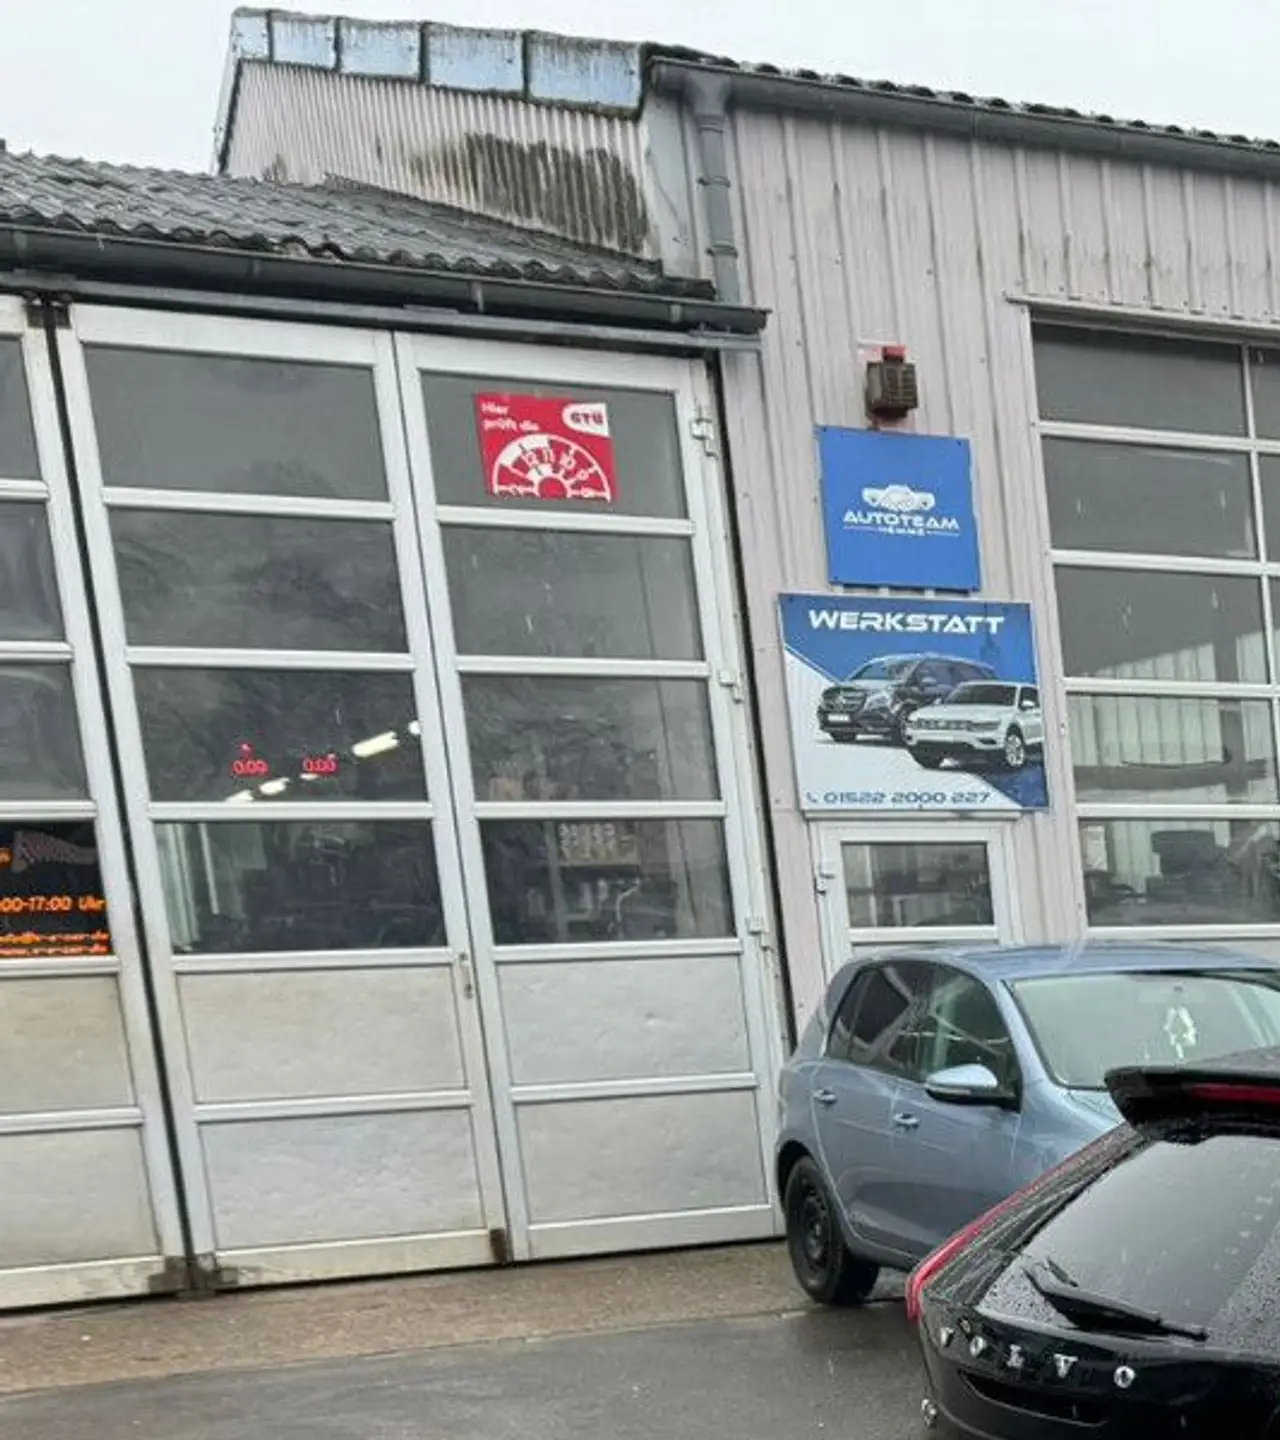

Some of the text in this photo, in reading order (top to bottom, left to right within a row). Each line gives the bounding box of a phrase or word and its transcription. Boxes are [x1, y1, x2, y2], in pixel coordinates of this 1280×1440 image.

[843, 509, 960, 530] AUTOTEAM
[808, 609, 1005, 635] WERKSTATT
[823, 791, 991, 804] 01522 2000 227
[940, 1327, 1137, 1389] VOLVO
